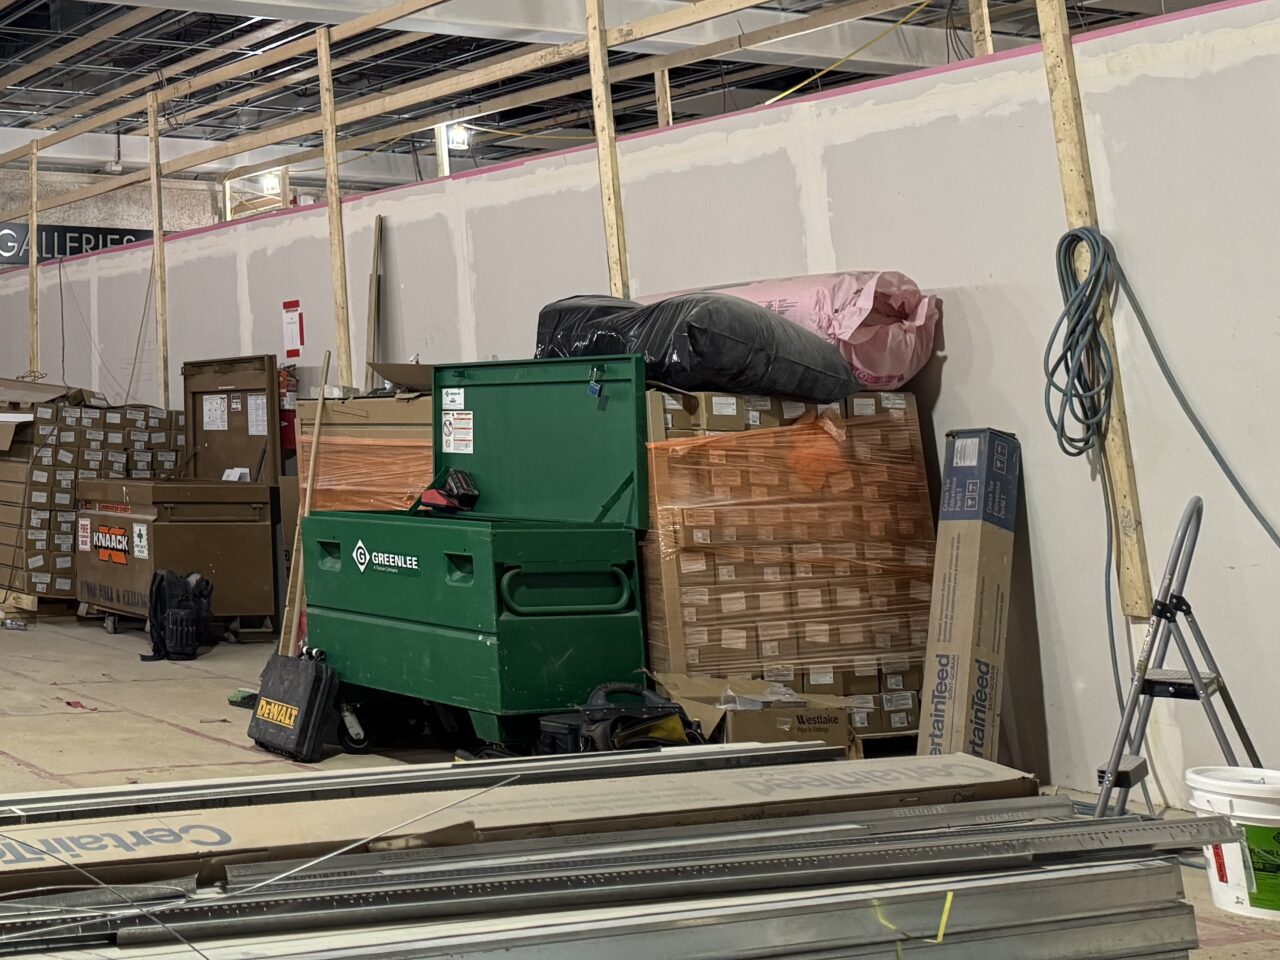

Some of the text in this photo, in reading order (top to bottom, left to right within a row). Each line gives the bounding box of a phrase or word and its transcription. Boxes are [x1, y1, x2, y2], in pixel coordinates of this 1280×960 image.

[93, 531, 129, 551] KNAACK
[371, 552, 418, 569] GREENLEE
[948, 653, 958, 701] SAINT-GOBAIN
[987, 664, 997, 712] SAINT-GOBAIN
[256, 699, 299, 726] DEWALT
[796, 714, 840, 725] Westlake
[929, 653, 951, 756] ertainTeed
[969, 658, 991, 758] rtainTeed
[742, 762, 995, 797] CertainTeed
